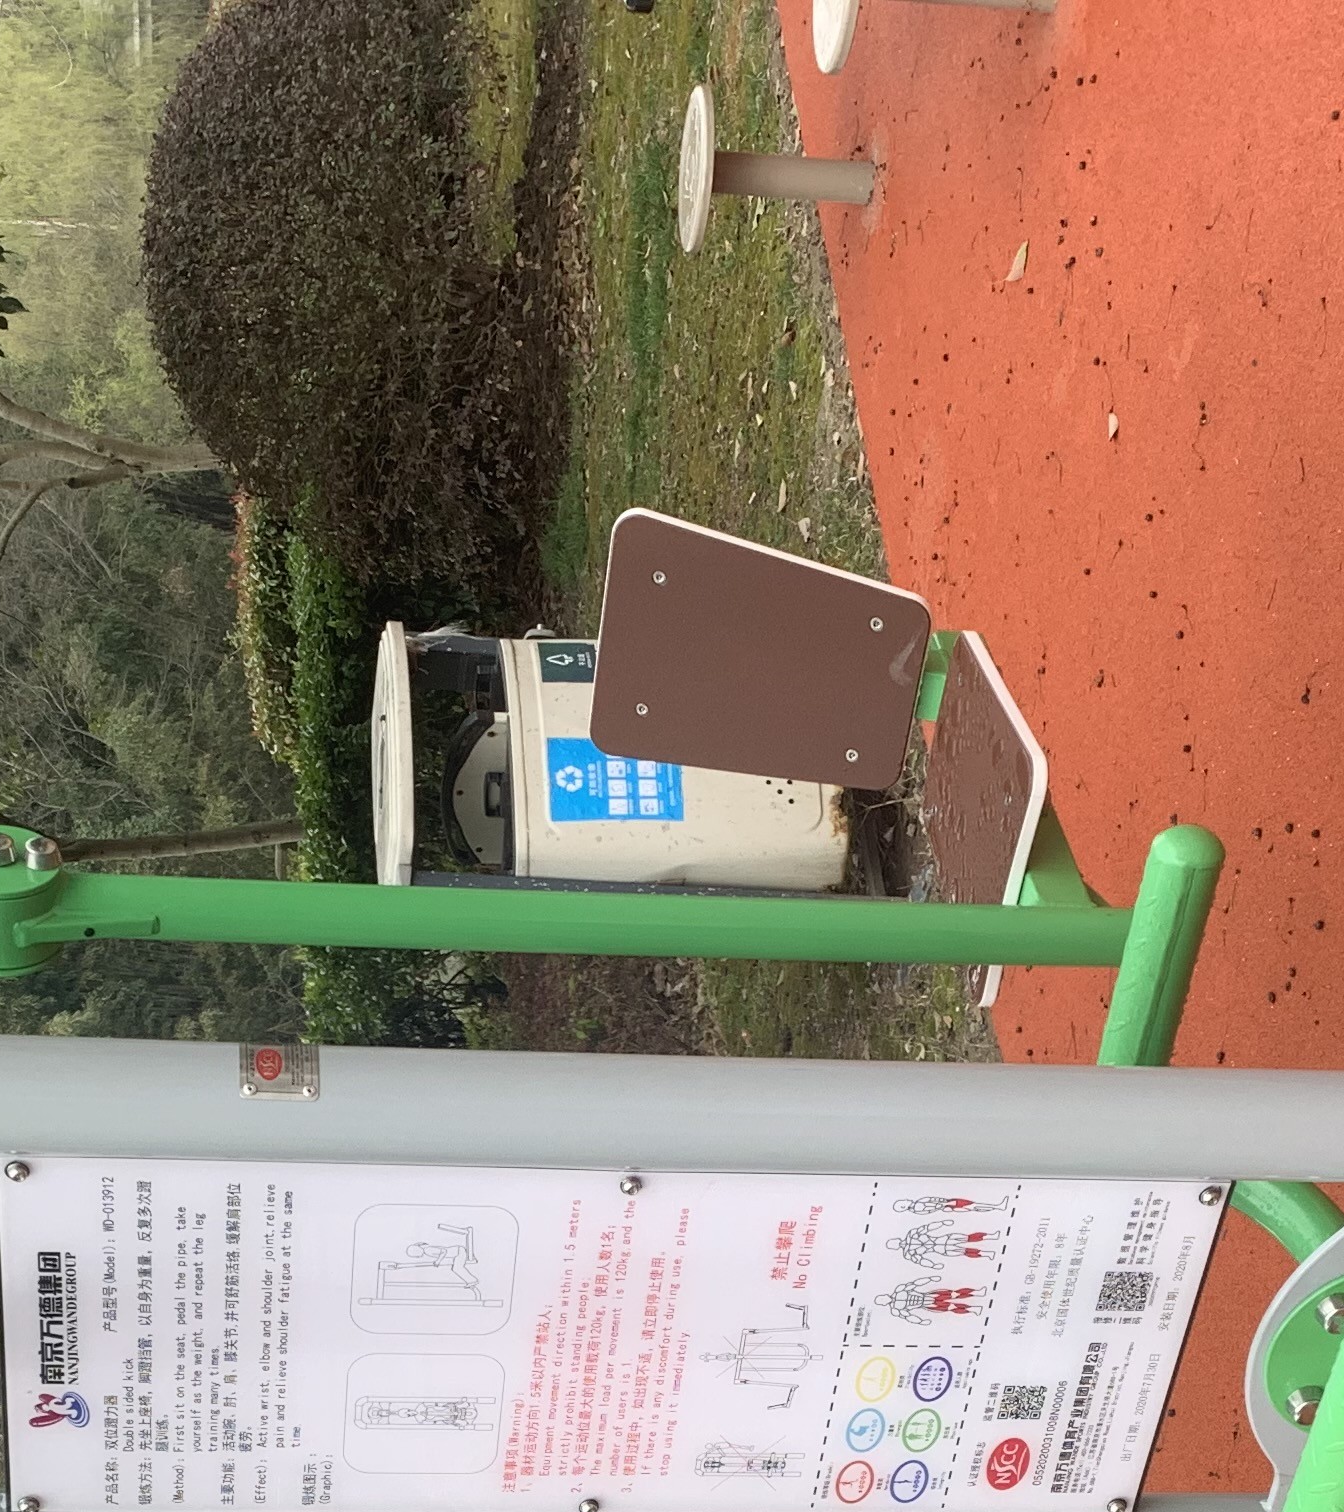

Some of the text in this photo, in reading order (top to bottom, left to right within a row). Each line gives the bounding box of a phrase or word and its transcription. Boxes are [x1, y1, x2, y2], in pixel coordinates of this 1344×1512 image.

[175, 1206, 186, 1230] take
[624, 1200, 636, 1219] the
[675, 1208, 690, 1246] please
[770, 1221, 797, 1280] 禁止攀爬
[792, 1205, 823, 1288] No Climbing
[175, 1272, 186, 1290] the
[1050, 1215, 1094, 1337] 北京国体世纪质量认证中心
[261, 1269, 273, 1314] shoulder
[613, 1289, 624, 1299] is
[664, 1283, 681, 1320] during
[38, 1252, 65, 1384] 南京万德集团
[65, 1252, 79, 1385] NANJINGWANDEGROUP
[174, 1297, 187, 1325] pedal
[275, 1191, 293, 1448] pain and relieve shoulder fatigue at the same
[191, 1213, 206, 1452] yourself as the weight, and repeat the leg
[260, 1320, 271, 1338] and
[540, 1199, 582, 1476] Equipment movement direction within 1.5 meters
[606, 1308, 621, 1356] movement
[260, 1343, 270, 1371] elbow
[570, 1325, 586, 1372] standing
[651, 1327, 672, 1385] discomfort
[173, 1364, 185, 1380] the
[603, 1363, 615, 1379] per
[619, 1374, 631, 1383] is
[123, 1358, 134, 1452] Double sided kick
[176, 1386, 185, 1398] on
[210, 1382, 221, 1405] many
[565, 1379, 577, 1425] prohibit
[596, 1385, 612, 1407] load
[616, 1391, 628, 1419] users
[653, 1391, 665, 1408] any
[983, 1382, 1001, 1422] 监管二维码
[173, 1404, 185, 1419] sit
[648, 1415, 660, 1424] is
[666, 1403, 678, 1413] it
[1050, 1342, 1102, 1493] 南京万德体育产业集团有限公司
[173, 1425, 185, 1453] First
[208, 1409, 220, 1452] training
[239, 1426, 252, 1452] 疲劳。
[257, 1415, 269, 1448] Active
[594, 1414, 607, 1454] maximum
[613, 1426, 623, 1437] of
[662, 1420, 677, 1448] using
[559, 1431, 573, 1476] strictly
[643, 1432, 657, 1459] there
[590, 1459, 602, 1476] The
[609, 1444, 621, 1476] number
[641, 1465, 650, 1475] If
[659, 1454, 671, 1476] stop
[967, 1441, 986, 1487] 认证授权标志
[991, 1443, 1018, 1484] NSCC
